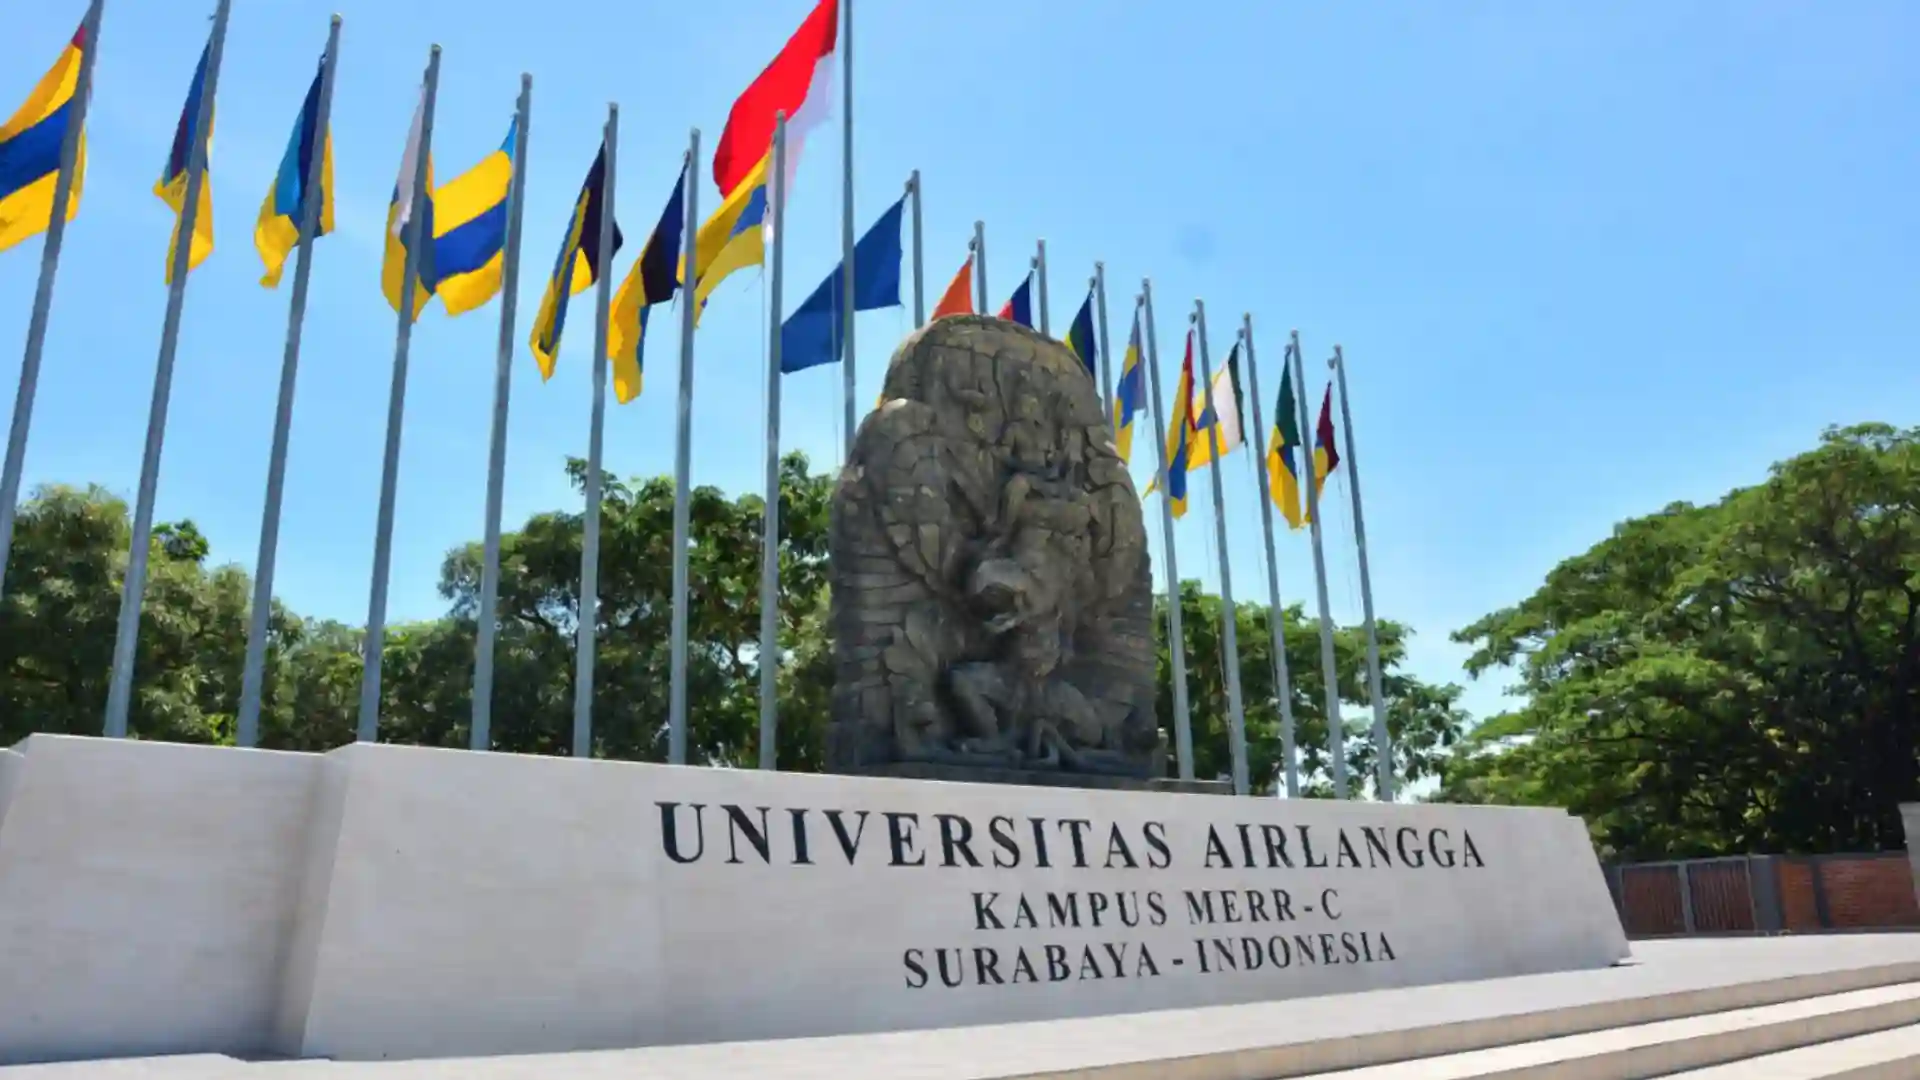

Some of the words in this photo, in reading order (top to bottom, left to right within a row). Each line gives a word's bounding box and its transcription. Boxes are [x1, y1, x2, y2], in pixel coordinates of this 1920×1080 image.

[654, 801, 1172, 869] UNIVERSITAS
[1204, 823, 1485, 869] AIRLANGGA
[972, 891, 1167, 930] KAMPUS
[1185, 888, 1343, 924] MERR-C
